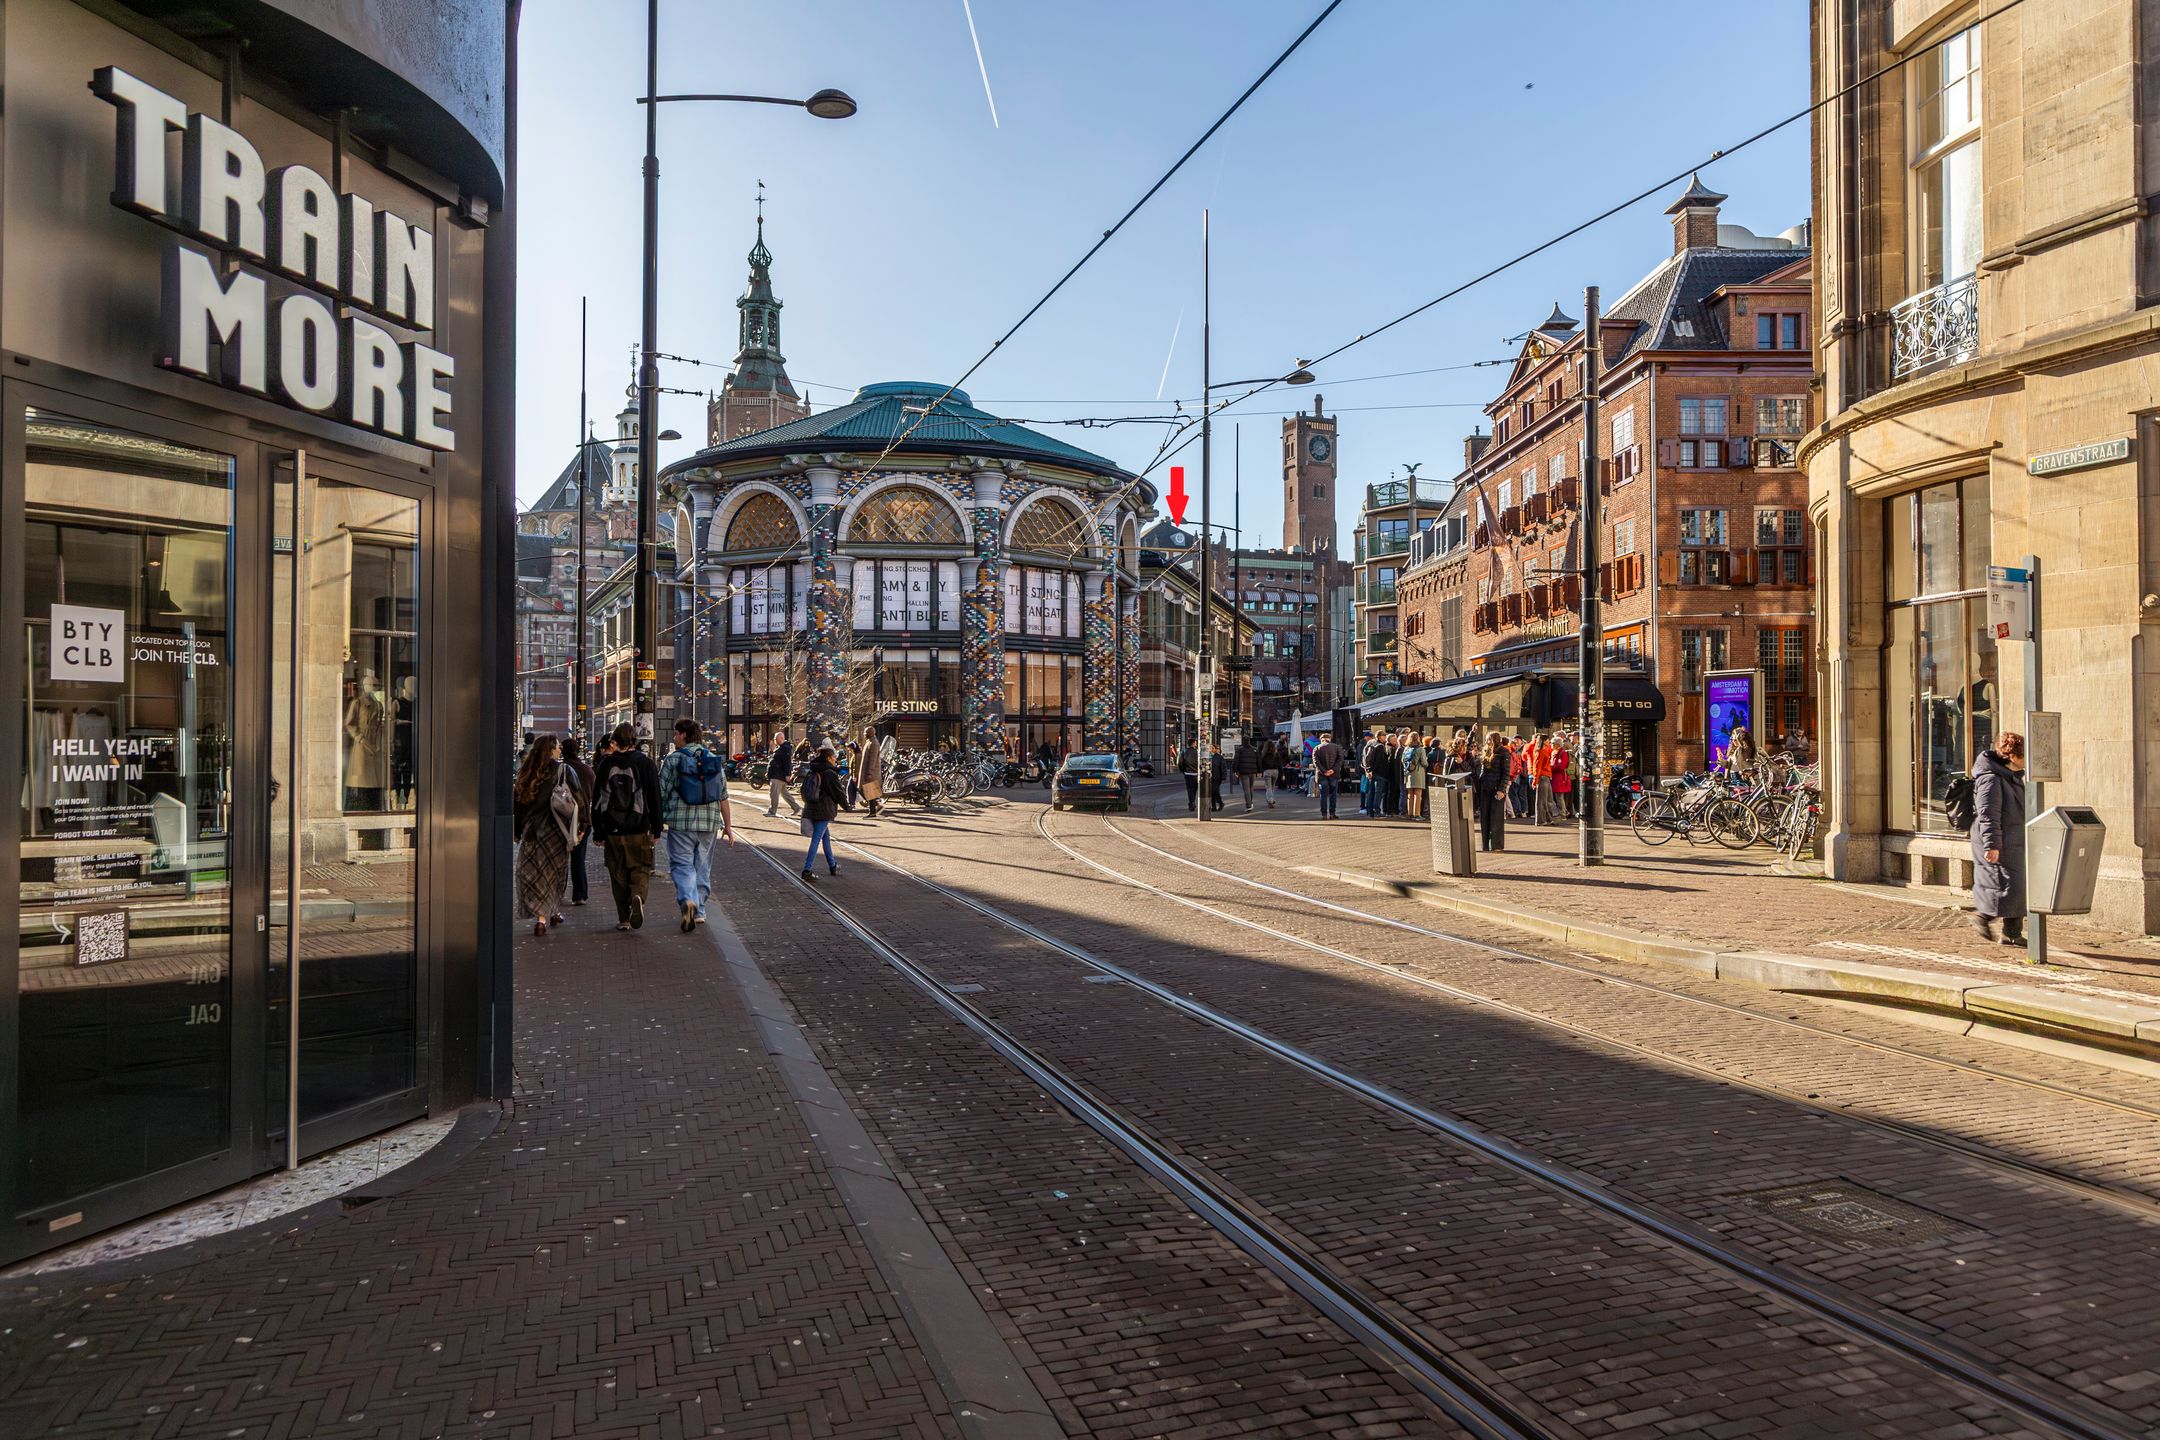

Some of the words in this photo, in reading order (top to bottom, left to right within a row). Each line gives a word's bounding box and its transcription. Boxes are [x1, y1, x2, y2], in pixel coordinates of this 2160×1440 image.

[110, 66, 433, 331] TRAIN
[178, 246, 455, 452] MORE
[2036, 442, 2119, 470] GRAVENSTRAAT
[895, 565, 930, 573] STOCKHOL
[881, 580, 907, 592] AMY
[912, 580, 921, 592] &
[926, 581, 946, 592] IY
[1991, 593, 1999, 602] 17
[741, 604, 764, 615] LST
[769, 601, 798, 613] MINS
[916, 610, 949, 621] BLE
[64, 620, 113, 642] BTY
[1548, 613, 1569, 638] Hooft
[131, 636, 162, 645] LOCATED
[163, 638, 175, 646] ON
[175, 639, 188, 647] TOP
[189, 640, 211, 648] FLOOR
[64, 646, 113, 667] CLB
[130, 649, 163, 662] JOIN
[166, 650, 190, 664] THE
[193, 652, 220, 666] CLB.
[1711, 680, 1743, 689] AMSTERDAM
[874, 700, 898, 712] THE
[901, 700, 938, 712] STING
[1617, 700, 1632, 708] TO
[1635, 701, 1652, 709] GO
[52, 738, 100, 756] HELL
[104, 738, 157, 759] YEAH,
[52, 764, 58, 783] I
[62, 764, 121, 782] WANT
[124, 763, 143, 780] IN
